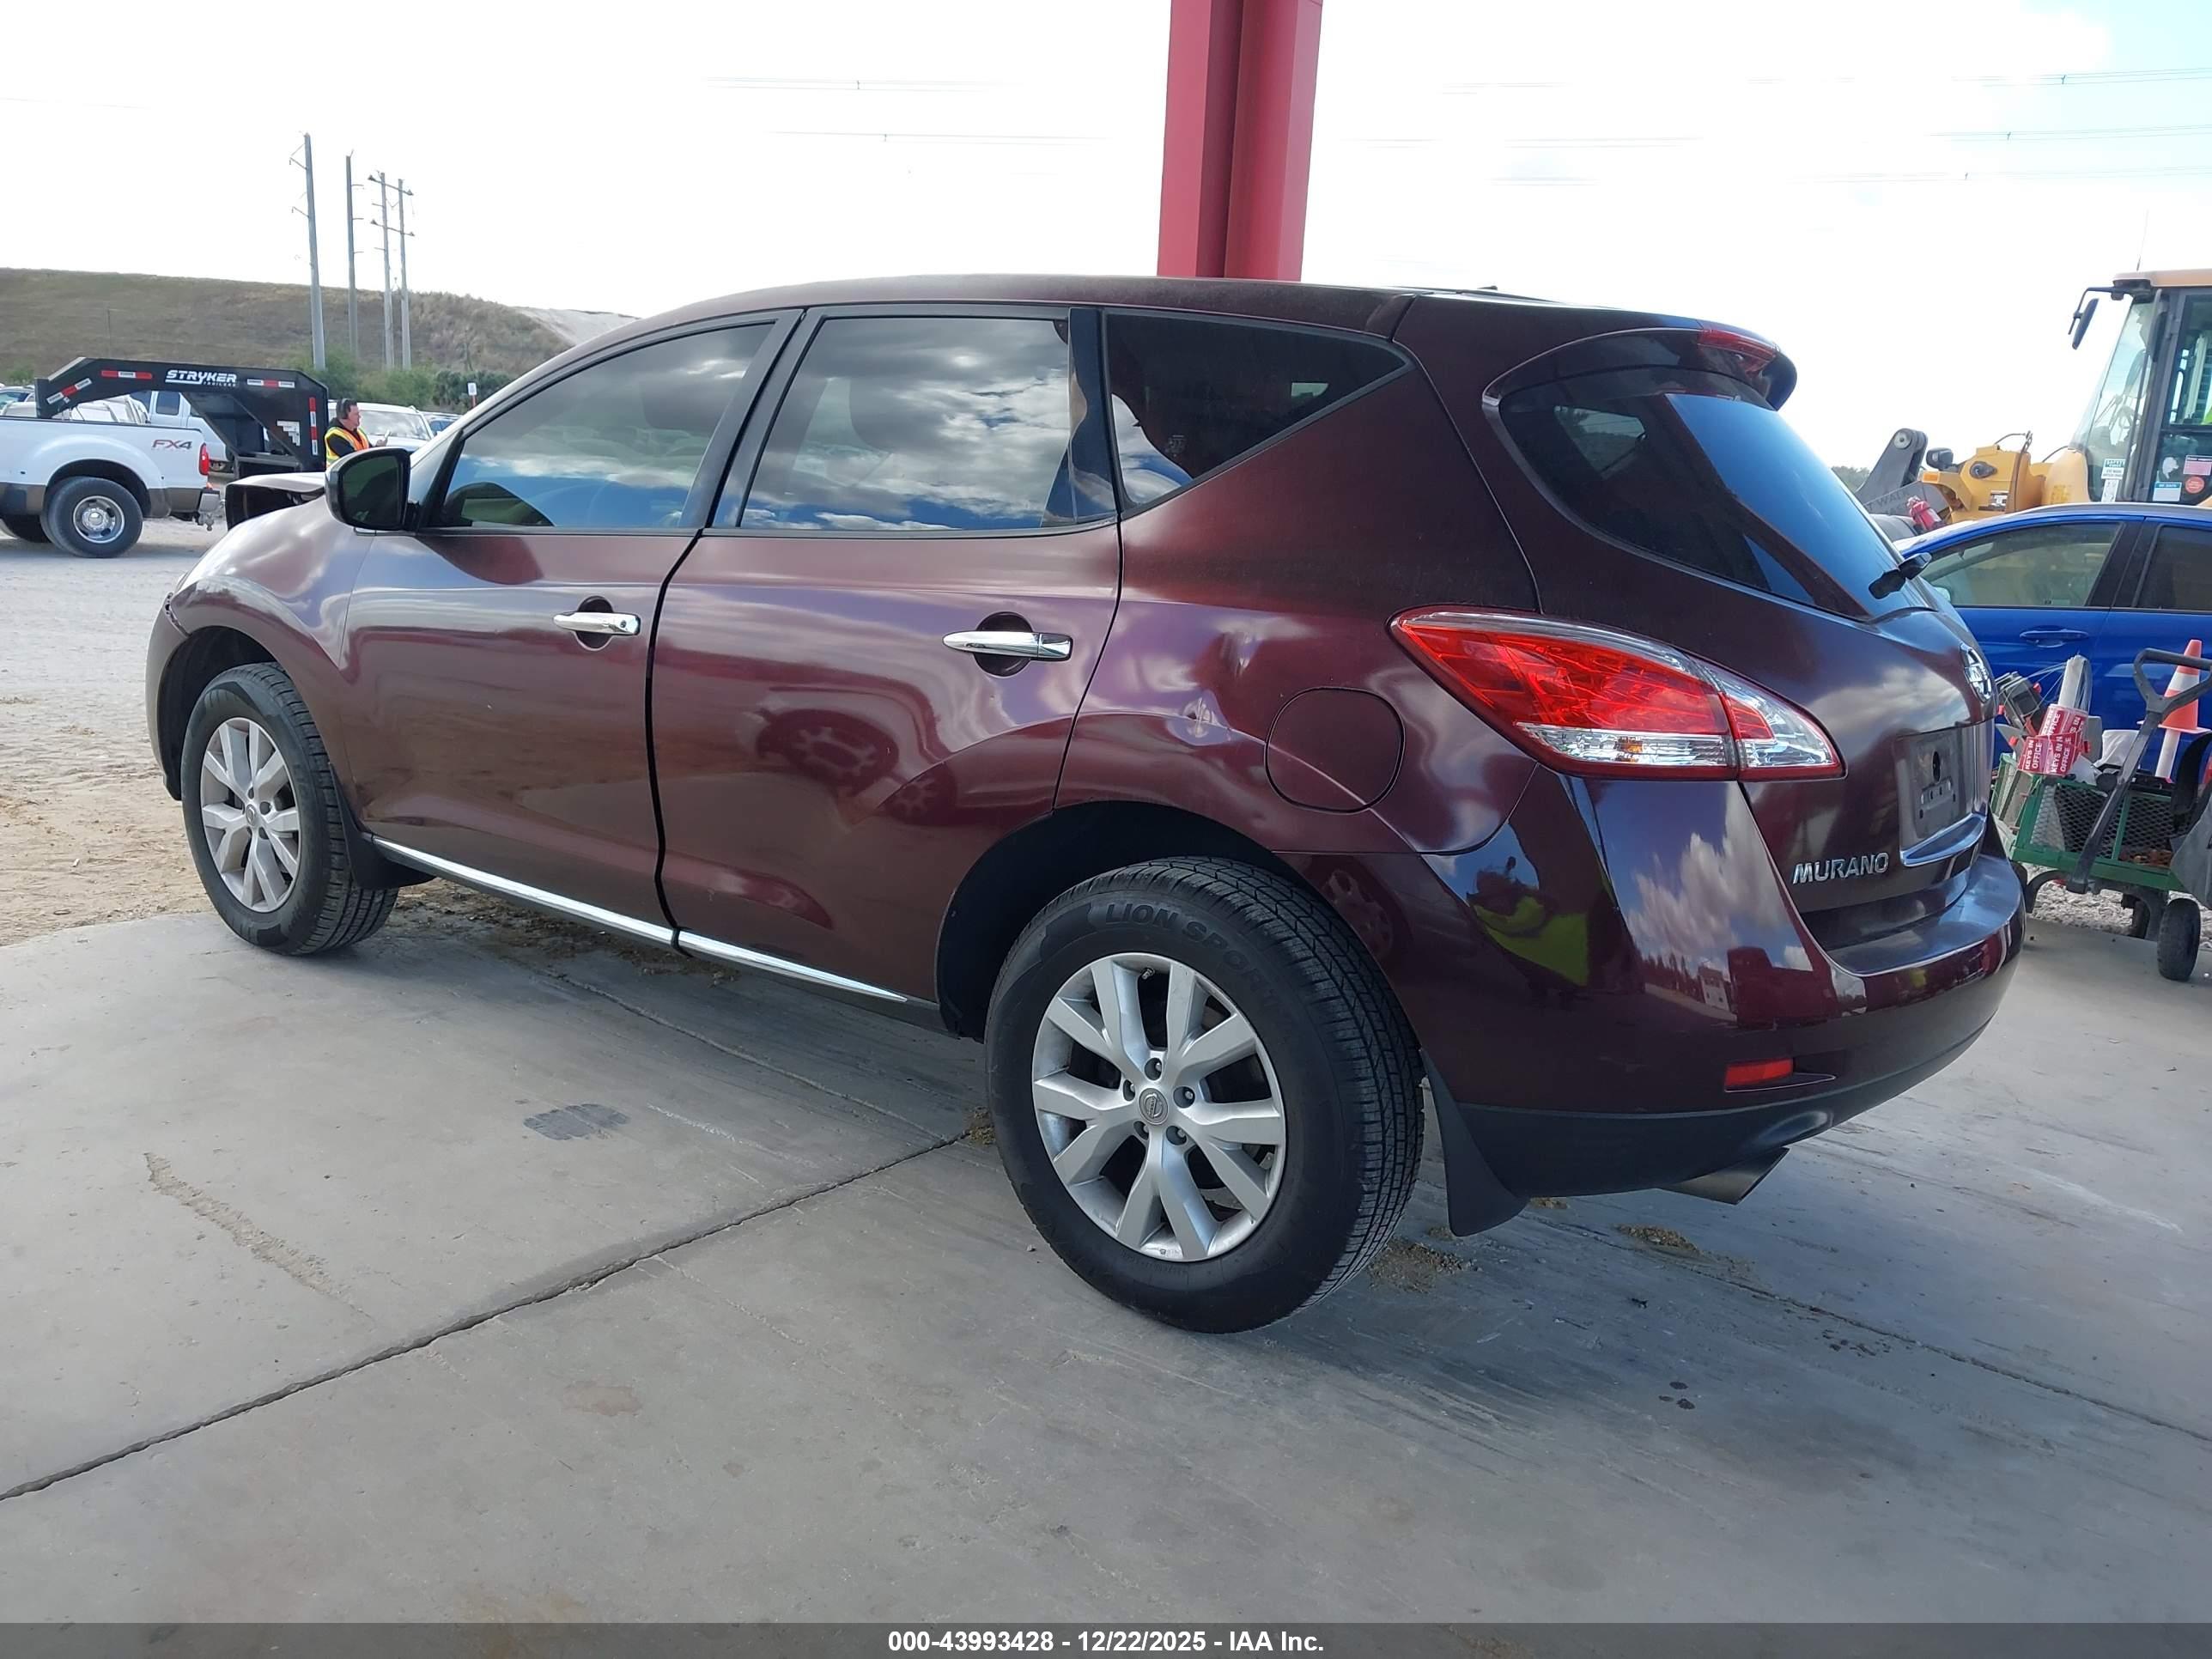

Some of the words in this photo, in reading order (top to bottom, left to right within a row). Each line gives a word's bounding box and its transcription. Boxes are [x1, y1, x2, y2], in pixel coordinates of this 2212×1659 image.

[165, 369, 238, 385] STRYKER
[151, 439, 192, 450] FX4
[2028, 739, 2034, 748] IN
[2032, 742, 2043, 769] OFFICE
[2025, 750, 2033, 769] KEYS
[2050, 753, 2061, 773] KEYS
[2056, 743, 2063, 752] IN
[2060, 747, 2070, 772] OFFICE
[1792, 852, 1889, 884] MURANO
[1105, 903, 1179, 929] LION
